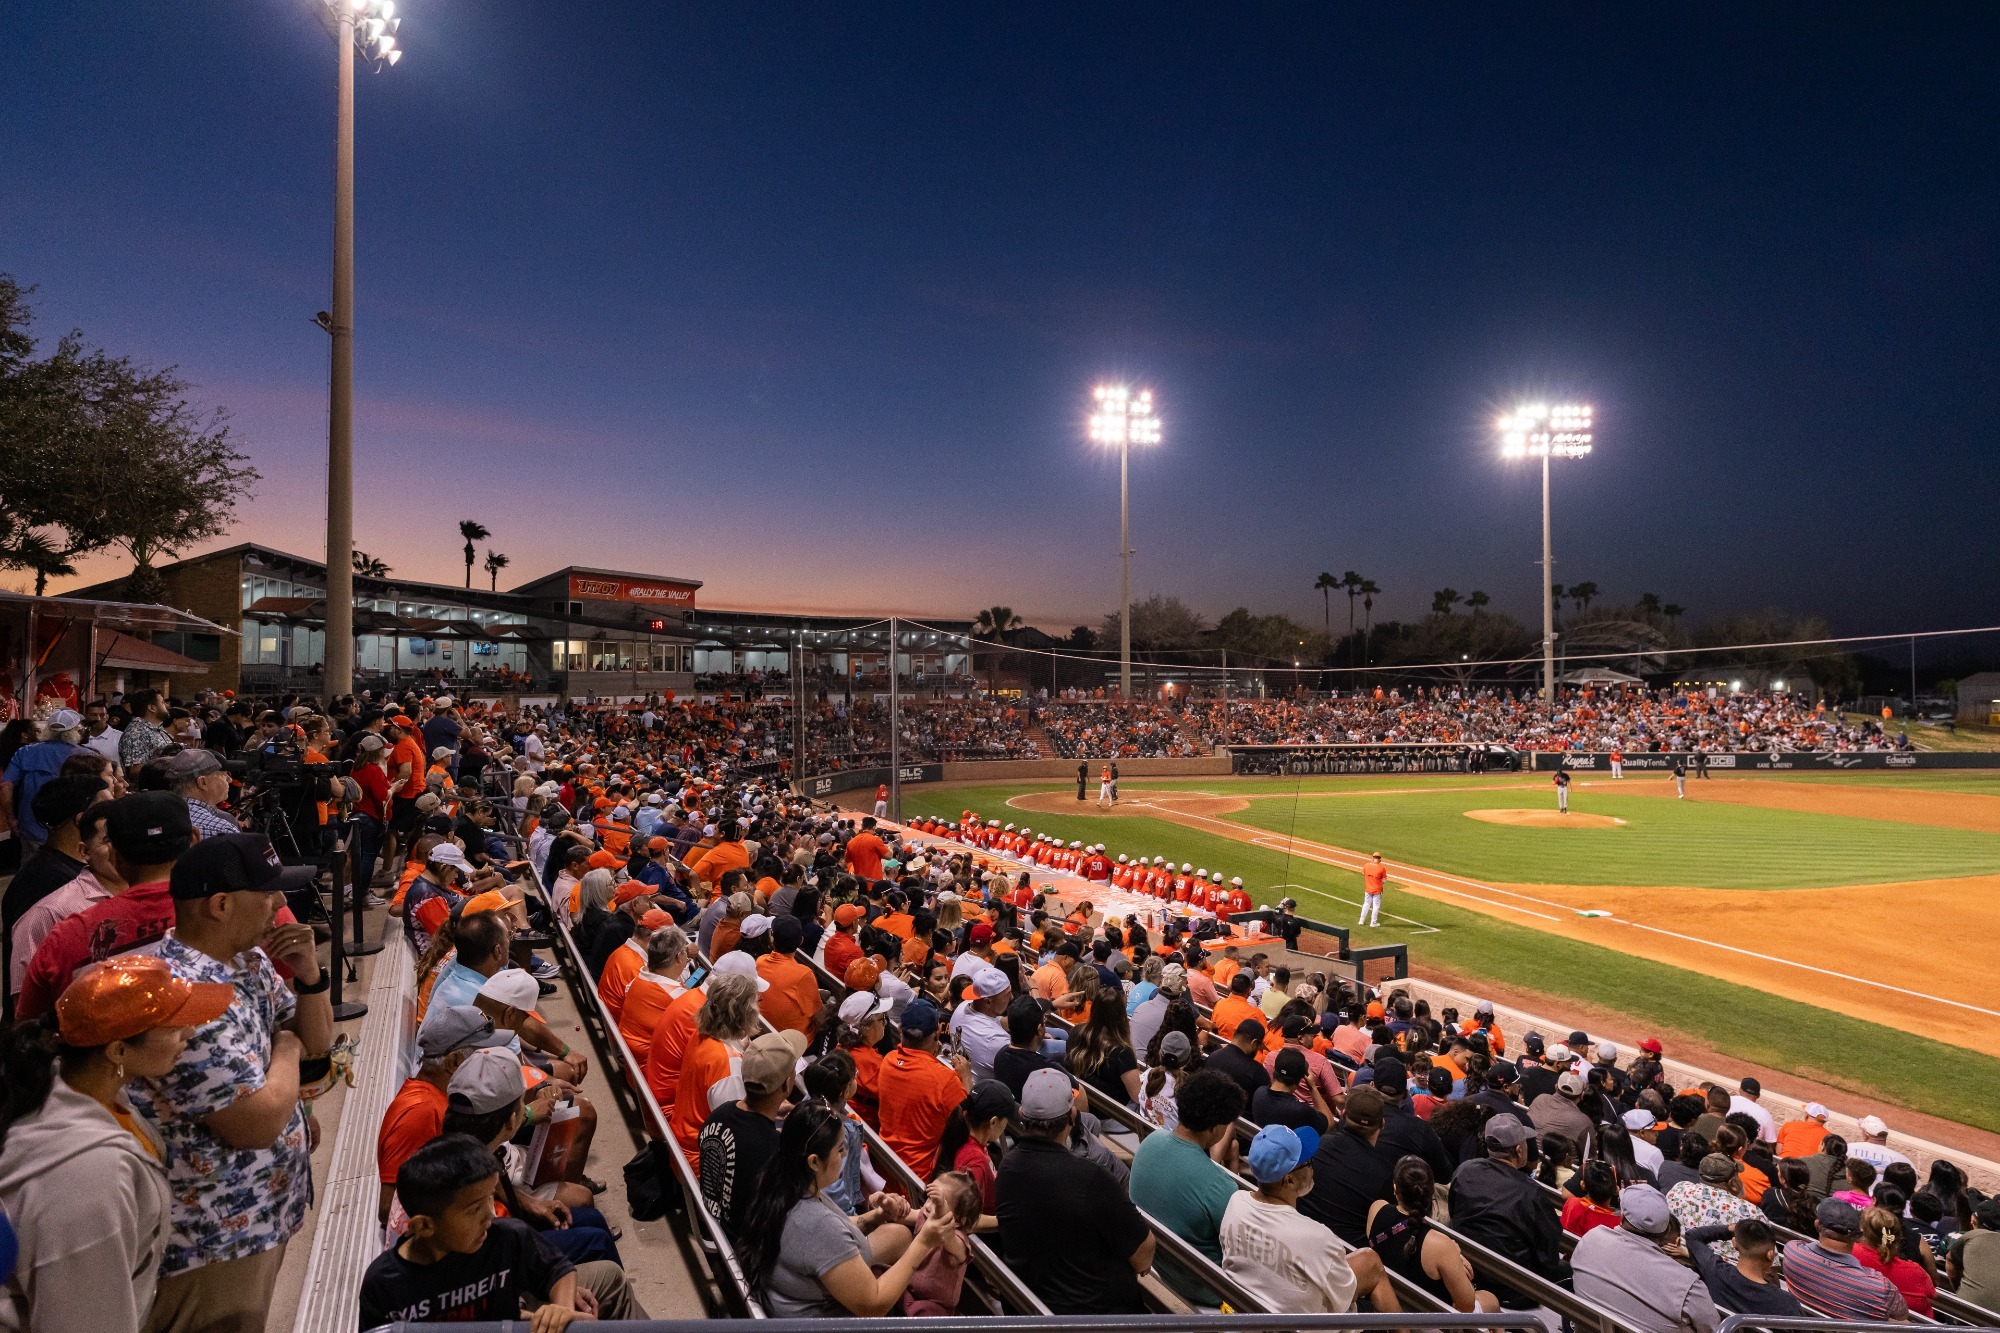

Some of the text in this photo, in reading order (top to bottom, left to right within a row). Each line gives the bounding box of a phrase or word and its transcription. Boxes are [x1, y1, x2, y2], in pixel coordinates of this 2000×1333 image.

[577, 580, 619, 595] UTRGV
[1712, 757, 1734, 765] JCB
[1886, 755, 1916, 764] Edwards
[1091, 862, 1103, 870] 50
[1175, 880, 1185, 889] 39
[1193, 886, 1203, 896] 14
[1210, 891, 1220, 902] 31
[1233, 898, 1243, 910] 17
[699, 1122, 723, 1143] SHOE
[437, 1269, 511, 1310] THREAT
